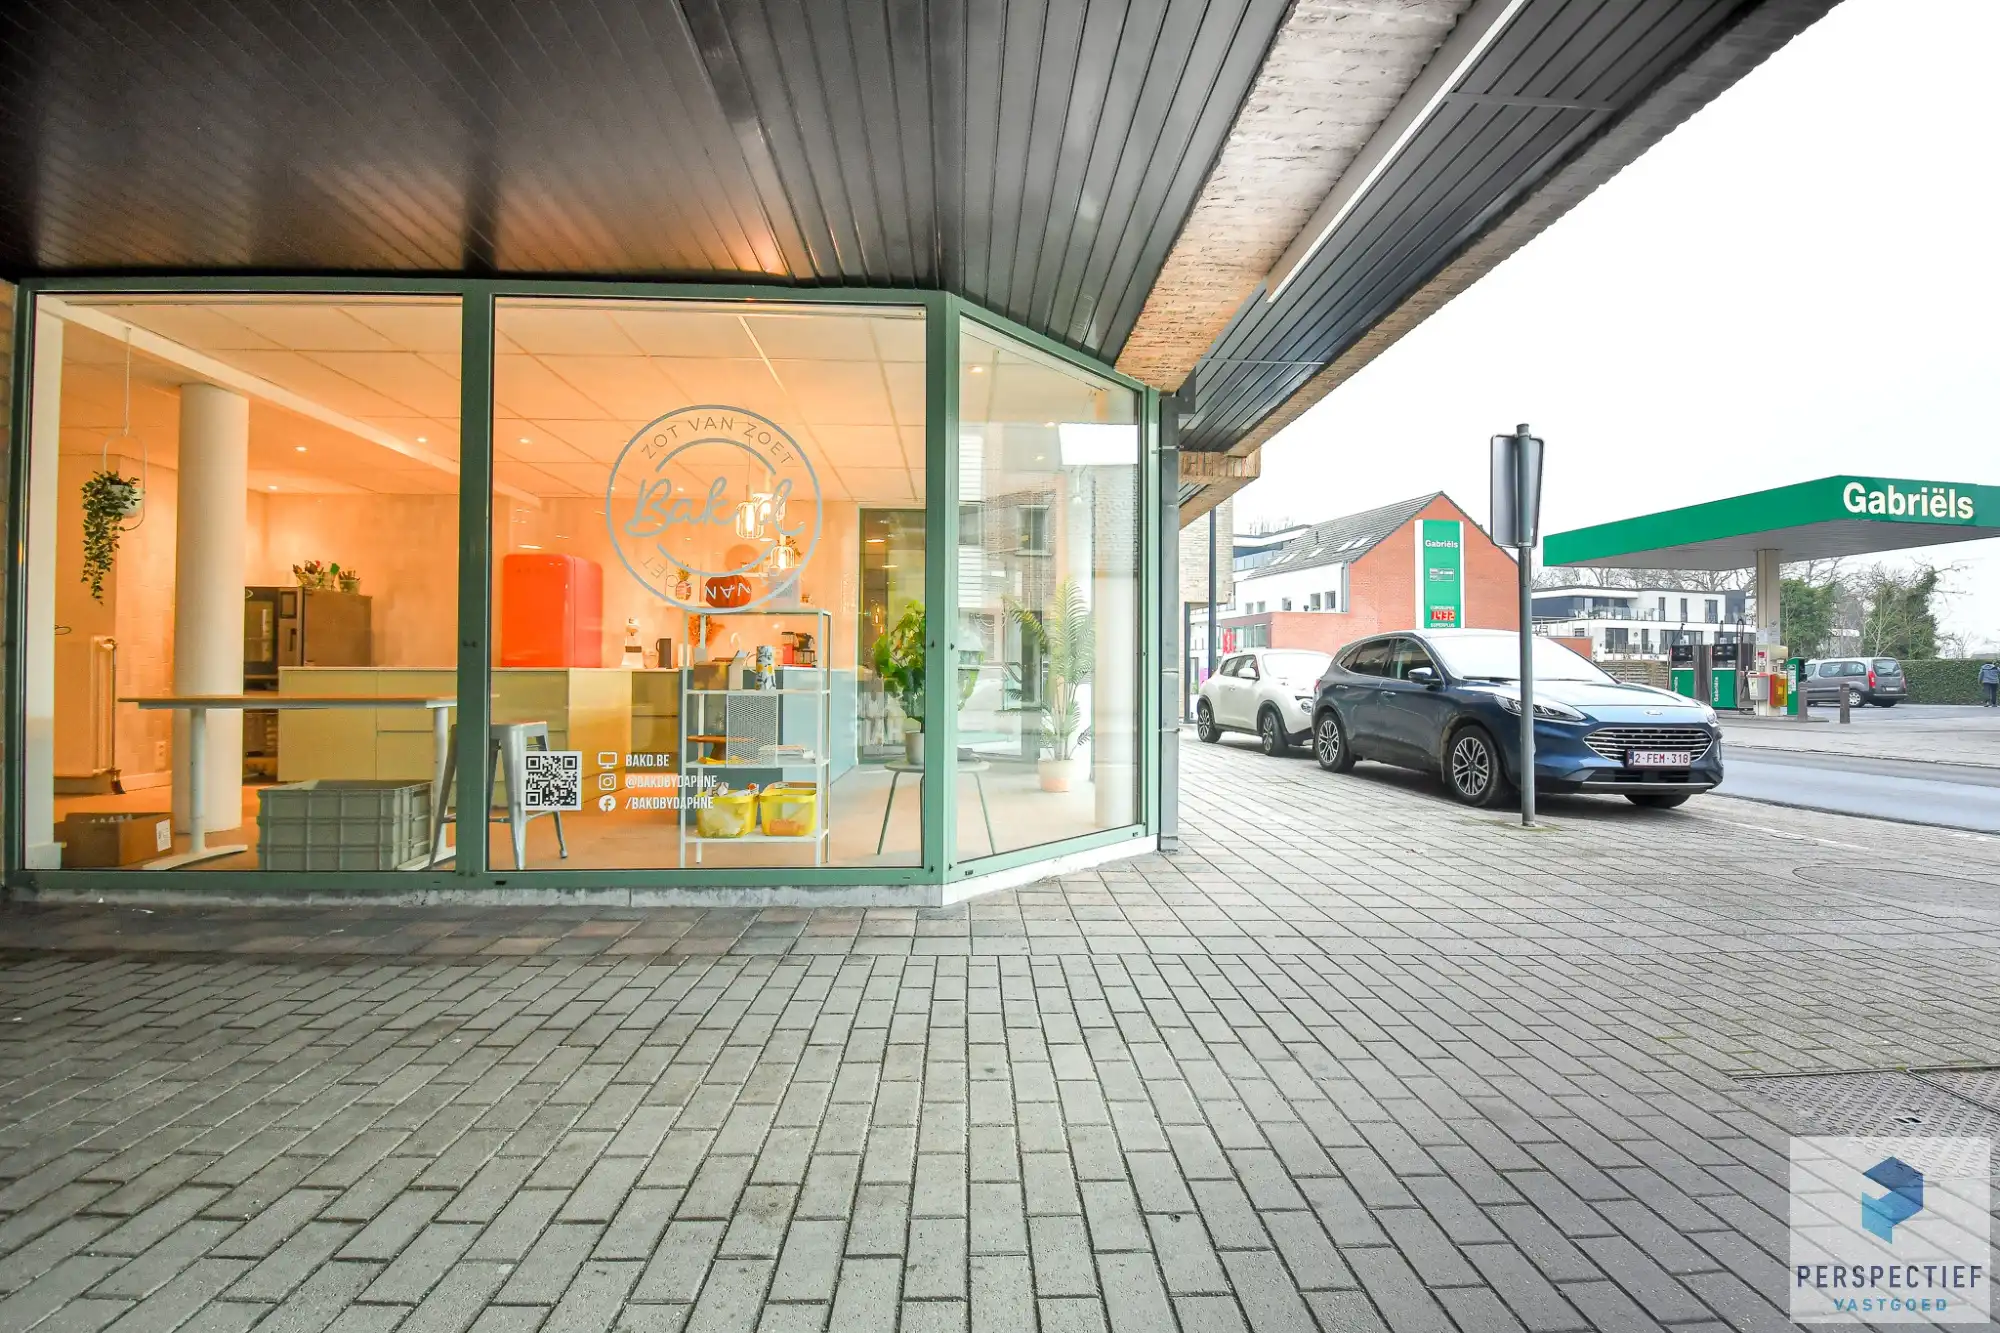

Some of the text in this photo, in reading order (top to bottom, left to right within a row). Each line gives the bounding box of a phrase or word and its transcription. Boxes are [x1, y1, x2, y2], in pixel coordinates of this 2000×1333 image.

[641, 416, 795, 465] ZOT VAN ZOET
[1843, 482, 1974, 519] Gabriëls
[1425, 539, 1459, 549] Gabriëls
[625, 754, 670, 767] BAKD.BE
[625, 775, 718, 789] @BAKDBYDAPHNE
[625, 796, 714, 810] /BAKDBYDAPHNE
